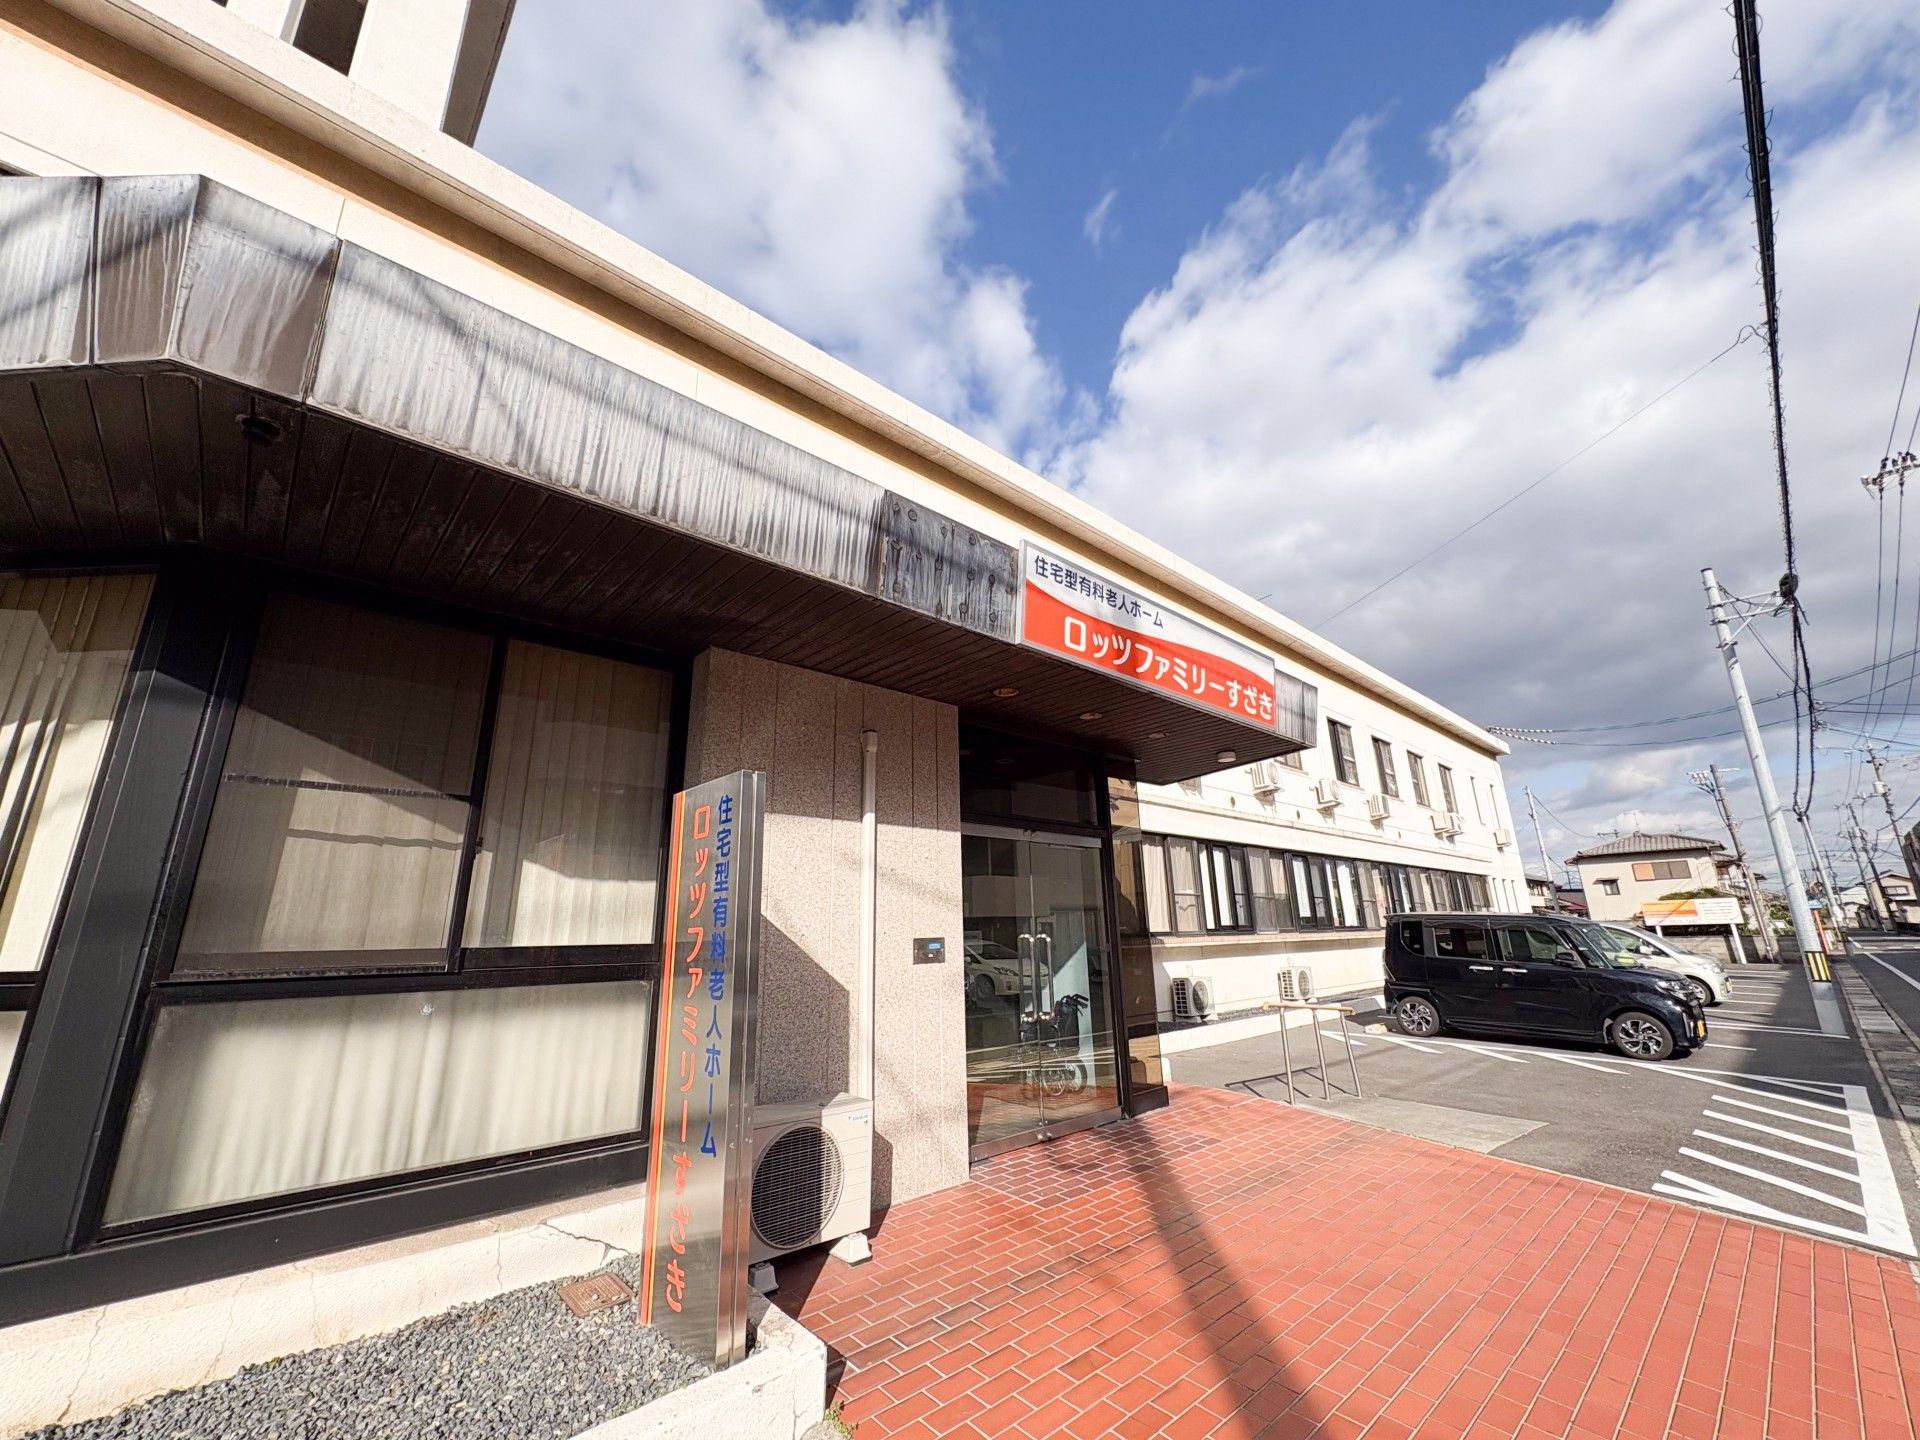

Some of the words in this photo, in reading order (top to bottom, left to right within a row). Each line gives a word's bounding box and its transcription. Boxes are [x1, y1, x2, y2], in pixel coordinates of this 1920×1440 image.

[1034, 554, 1164, 629] 住宅型有料老人ホーム
[1063, 615, 1273, 721] ロッツファミリーすざき
[665, 804, 711, 1313] ロッツファミリーすざき
[700, 793, 734, 1158] 住宅型有料老人ホーム
